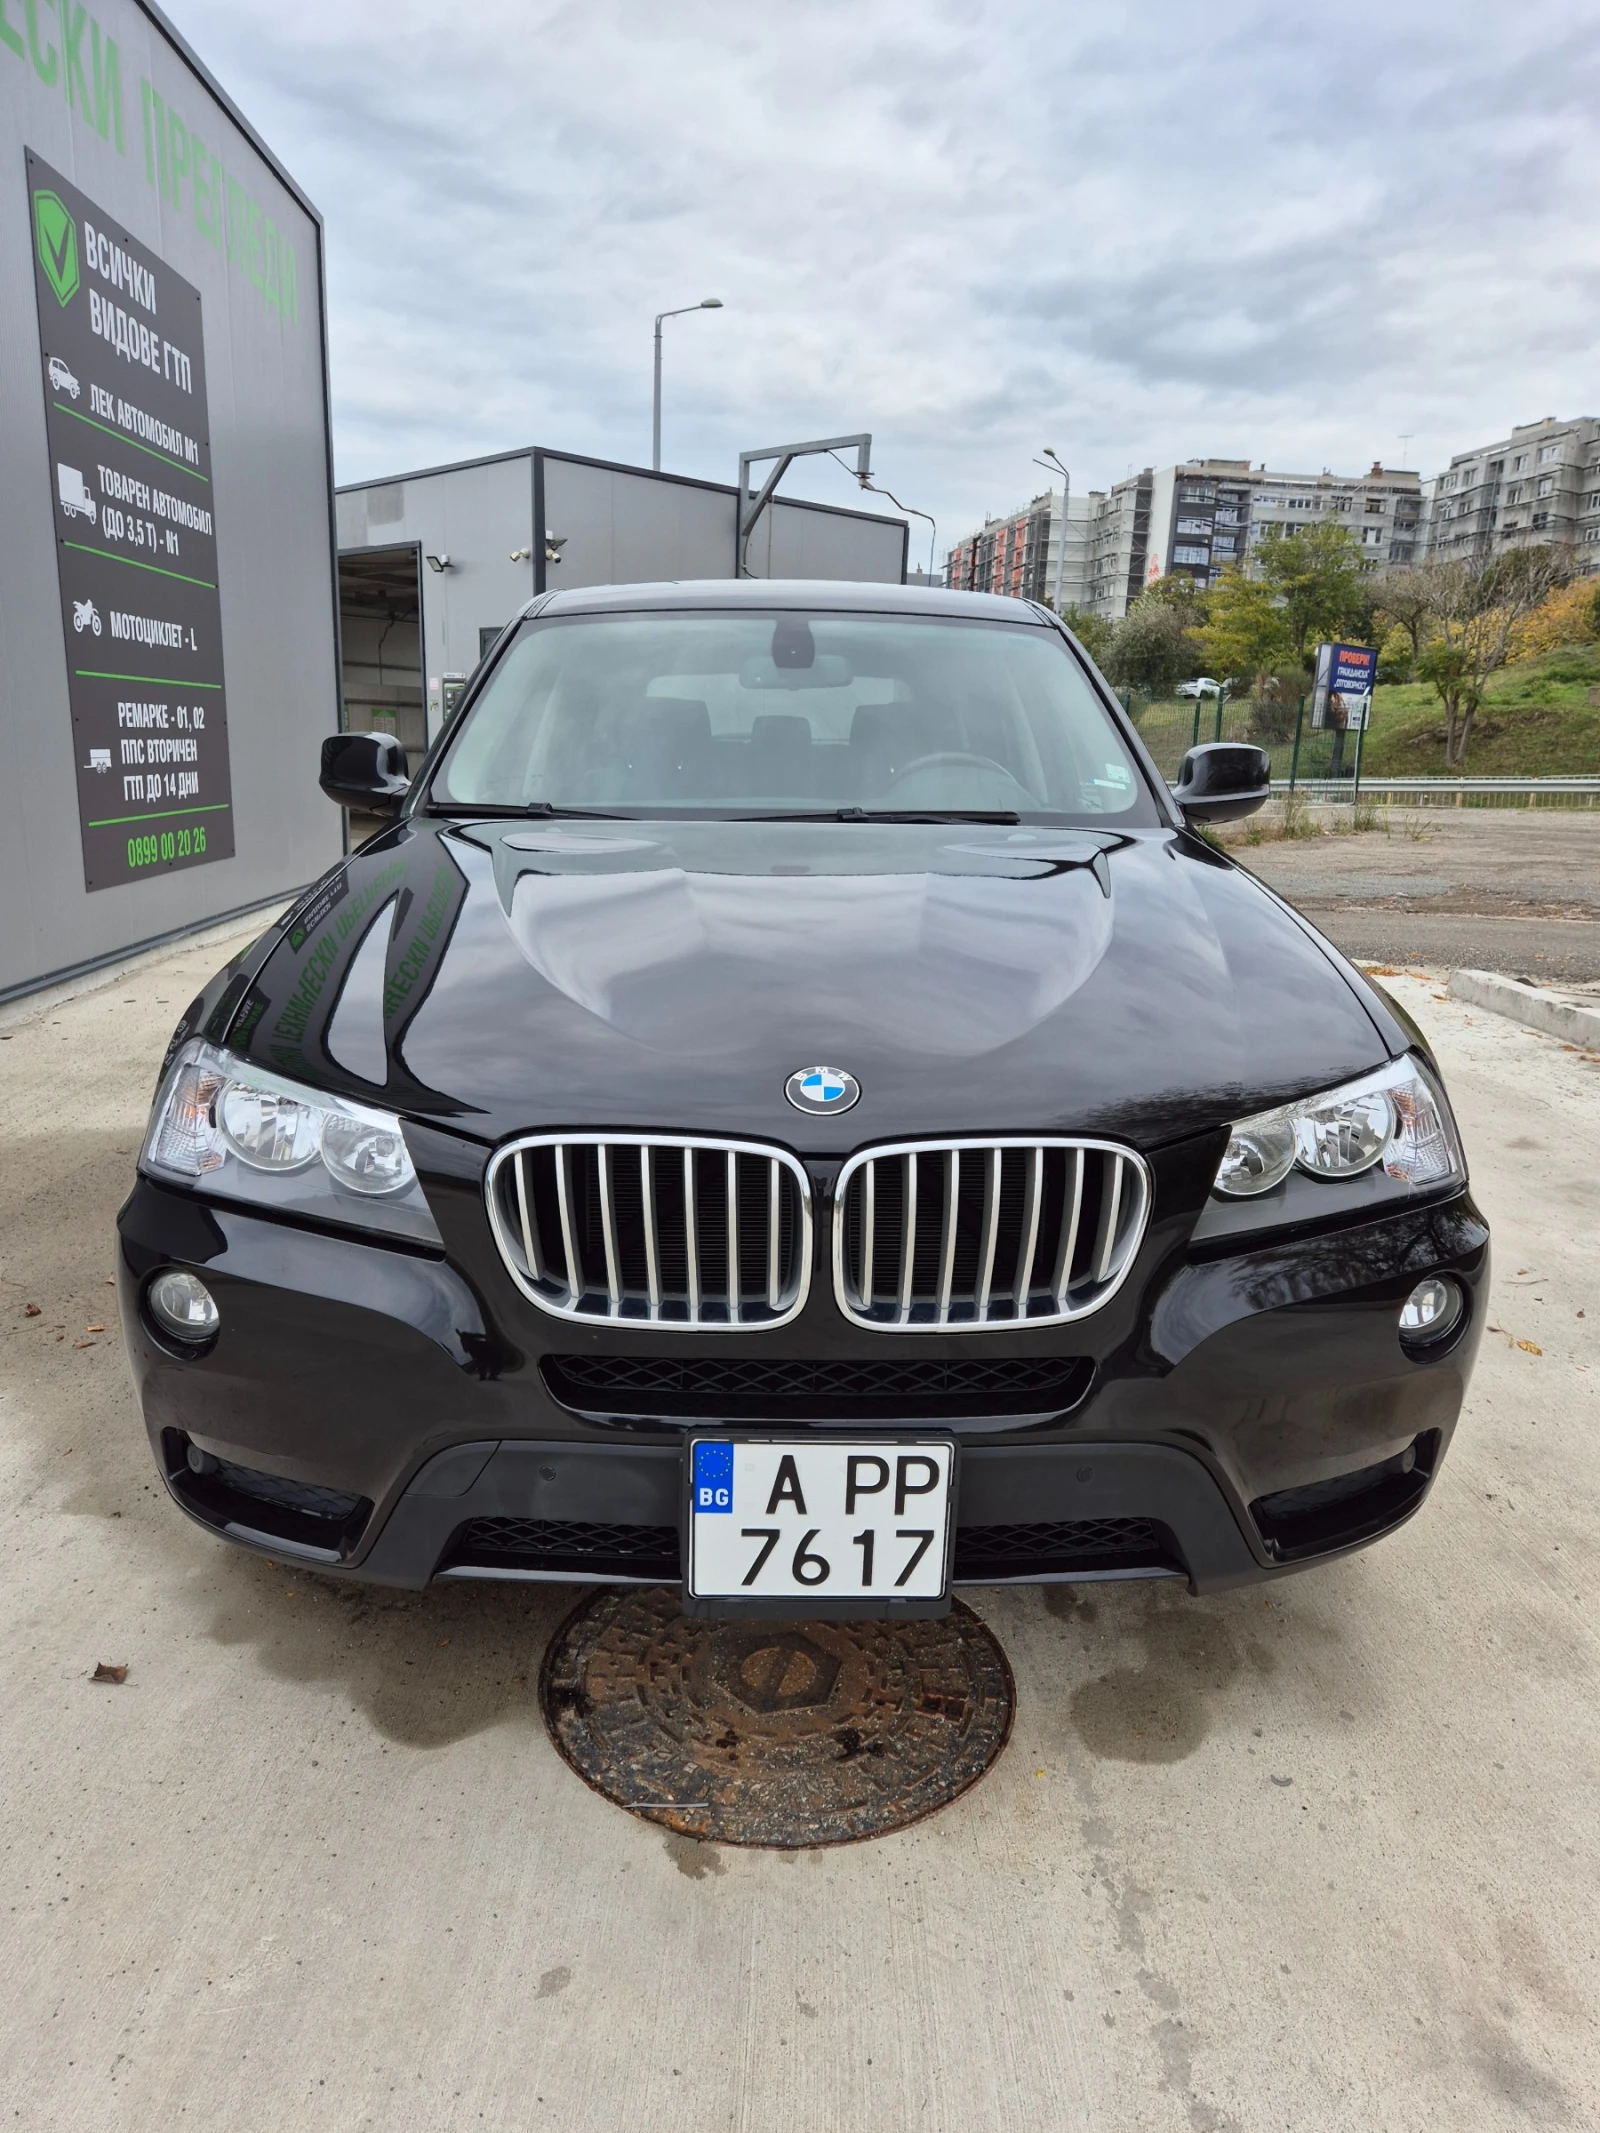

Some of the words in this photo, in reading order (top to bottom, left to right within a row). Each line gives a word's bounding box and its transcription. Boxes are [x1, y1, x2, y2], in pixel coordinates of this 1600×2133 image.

[141, 75, 298, 328] ПРЕГЛЕДИ
[84, 221, 157, 315] ВСИЧКИ
[89, 288, 161, 374] ВИДОВЕ
[163, 341, 192, 394] ГТП
[90, 383, 115, 422] ЛЕК
[117, 398, 183, 457] АВТОМОБИЛ
[97, 464, 151, 511] ТОВАРЕН
[152, 488, 213, 536] АВТОМОБИЛ
[102, 505, 124, 541] (ДО
[126, 515, 145, 546] 3,5
[165, 529, 179, 556] N1
[110, 611, 182, 648] МОТОЦИКЛЕТ
[191, 627, 198, 651] L
[1338, 650, 1370, 666] ПРОВЕРИ!
[118, 702, 169, 728] РЕМАРКЕ
[121, 739, 145, 764] ППС
[147, 739, 198, 763] ВТОРИЧЕН
[124, 775, 144, 801] ГТП
[147, 773, 162, 803] ДО
[164, 773, 176, 797] 14
[179, 771, 199, 799] ДНИ
[128, 834, 158, 868] 0899
[161, 831, 175, 860] 00
[178, 829, 191, 857] 20
[193, 826, 206, 854] 26
[792, 1067, 853, 1081] BMW
[699, 1488, 729, 1506] BG
[765, 1455, 807, 1514] A
[845, 1455, 940, 1515] PP
[741, 1528, 934, 1586] 7617
